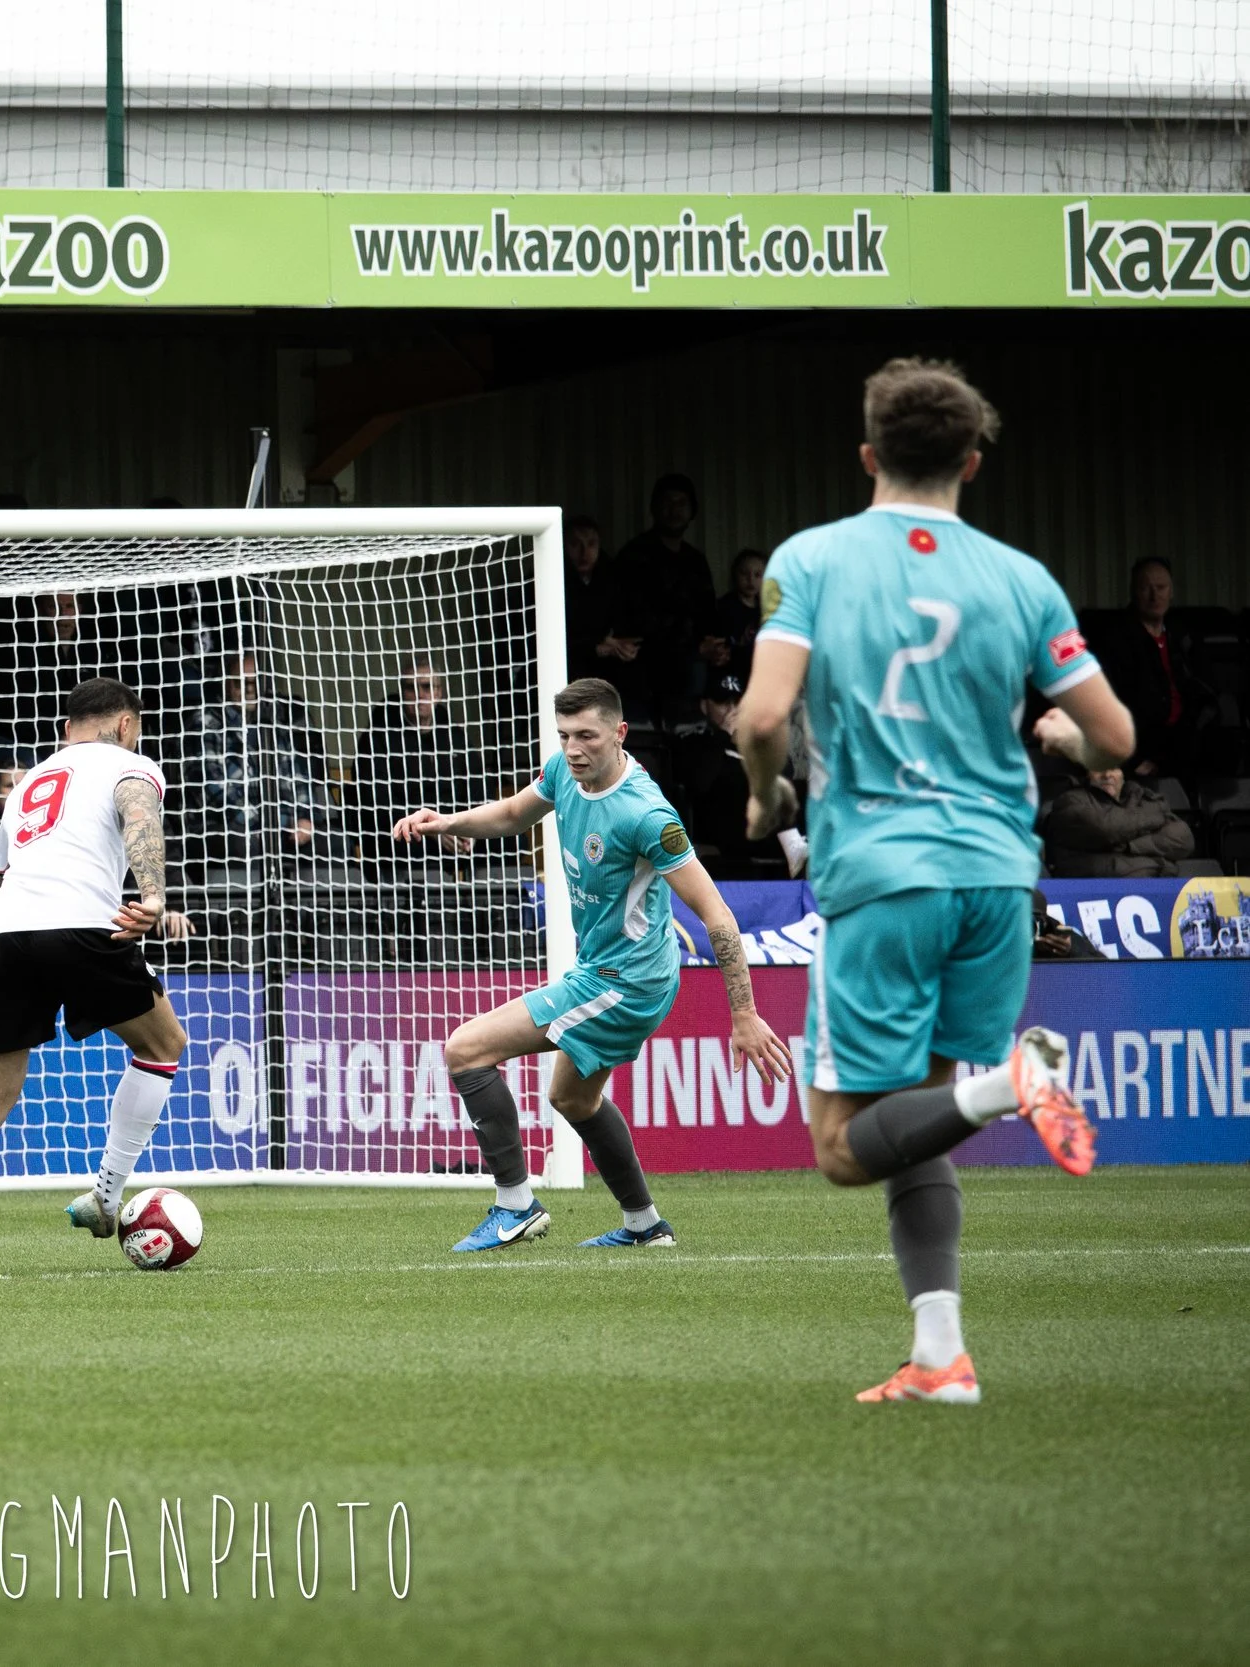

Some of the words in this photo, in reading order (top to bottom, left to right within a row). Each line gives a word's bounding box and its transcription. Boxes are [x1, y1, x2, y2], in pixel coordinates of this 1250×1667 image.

[351, 208, 889, 292] www.kazooprint.co.uk
[876, 597, 961, 721] 2
[14, 767, 74, 849] 9
[209, 1041, 476, 1134] OFICIA
[1072, 1029, 1250, 1119] ARTNE
